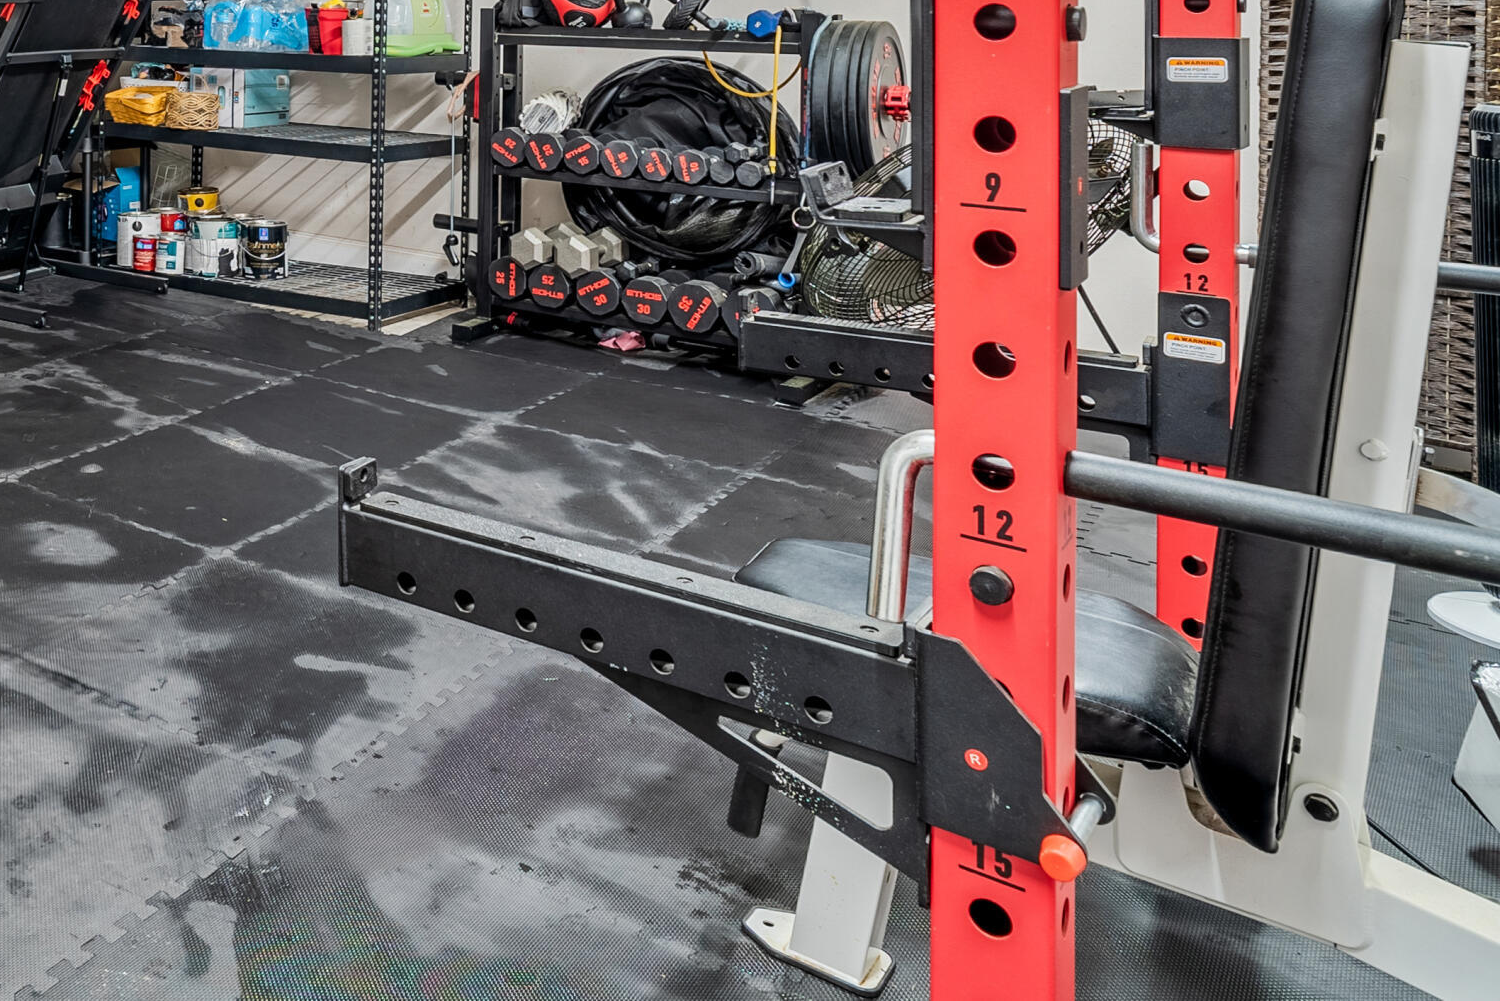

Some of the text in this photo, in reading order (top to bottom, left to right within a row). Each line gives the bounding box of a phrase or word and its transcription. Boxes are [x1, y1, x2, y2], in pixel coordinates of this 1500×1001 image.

[504, 138, 517, 150] 20
[542, 144, 554, 157] 20
[985, 172, 1001, 202] 9
[495, 271, 505, 285] 25
[542, 275, 555, 285] 25
[1183, 273, 1209, 292] 12
[532, 288, 565, 299] ETHOS
[578, 278, 610, 296] ETHOS
[593, 294, 607, 306] 30
[626, 289, 662, 302] ETHOS
[637, 303, 651, 315] 30
[678, 295, 693, 312] 35
[686, 297, 712, 330] ETHOS
[1182, 336, 1217, 346] WARNING
[973, 505, 1013, 542] 12
[972, 840, 1012, 879] 15
